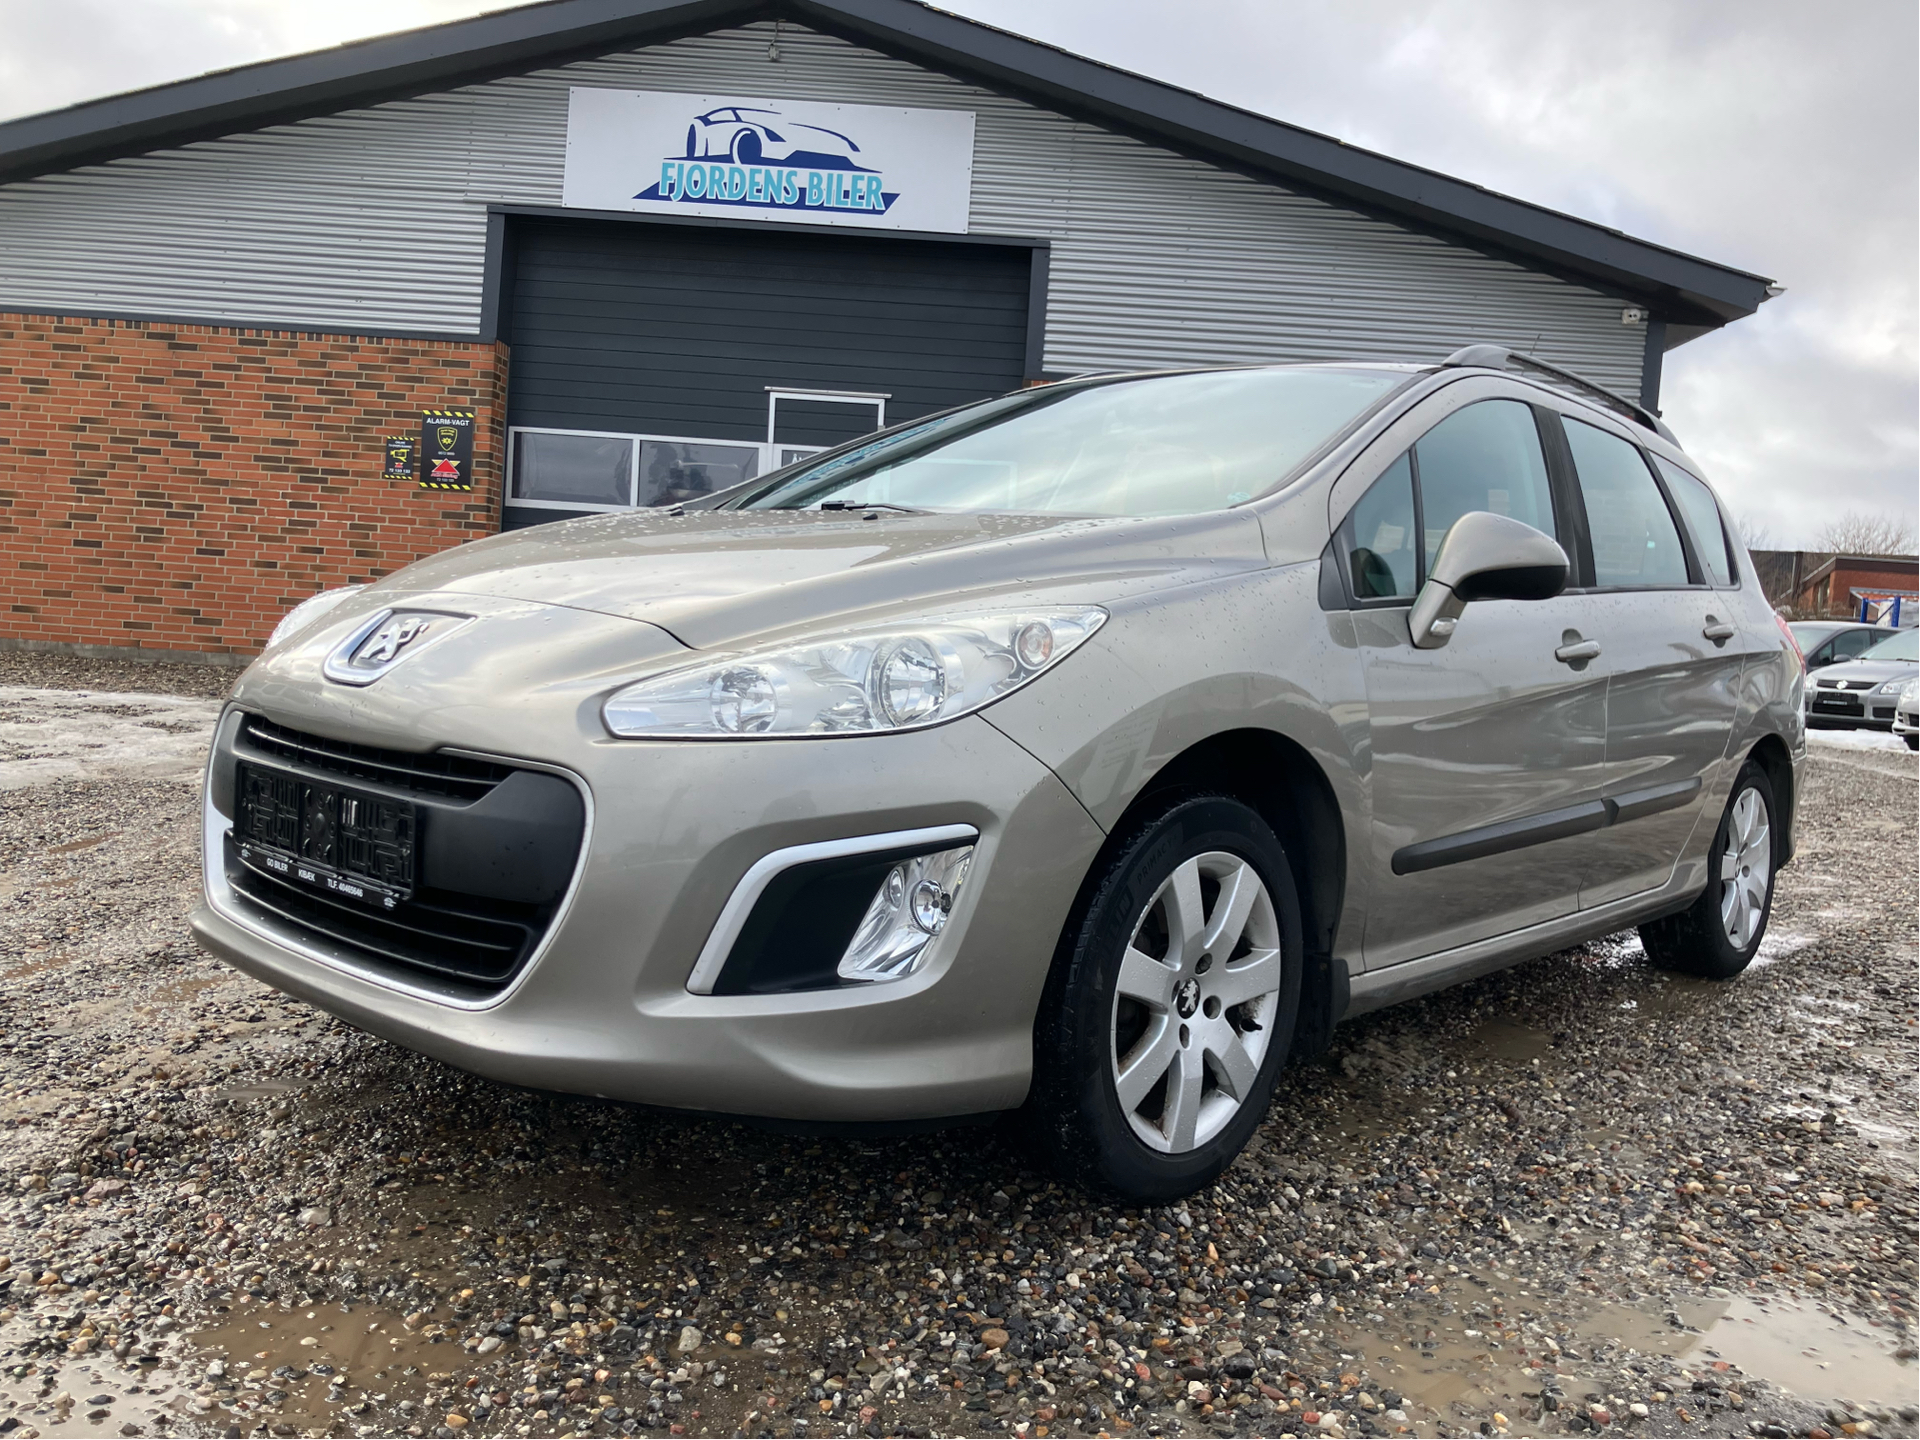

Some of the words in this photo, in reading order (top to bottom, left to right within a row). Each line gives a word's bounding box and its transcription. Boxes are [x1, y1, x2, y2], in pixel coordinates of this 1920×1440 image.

[659, 163, 798, 204] FJORDENS
[806, 172, 884, 210] BILER
[426, 418, 470, 427] ALARM-VAGT
[266, 857, 274, 867] GO
[274, 861, 288, 872] BILER
[1137, 838, 1172, 885] PRIMACY
